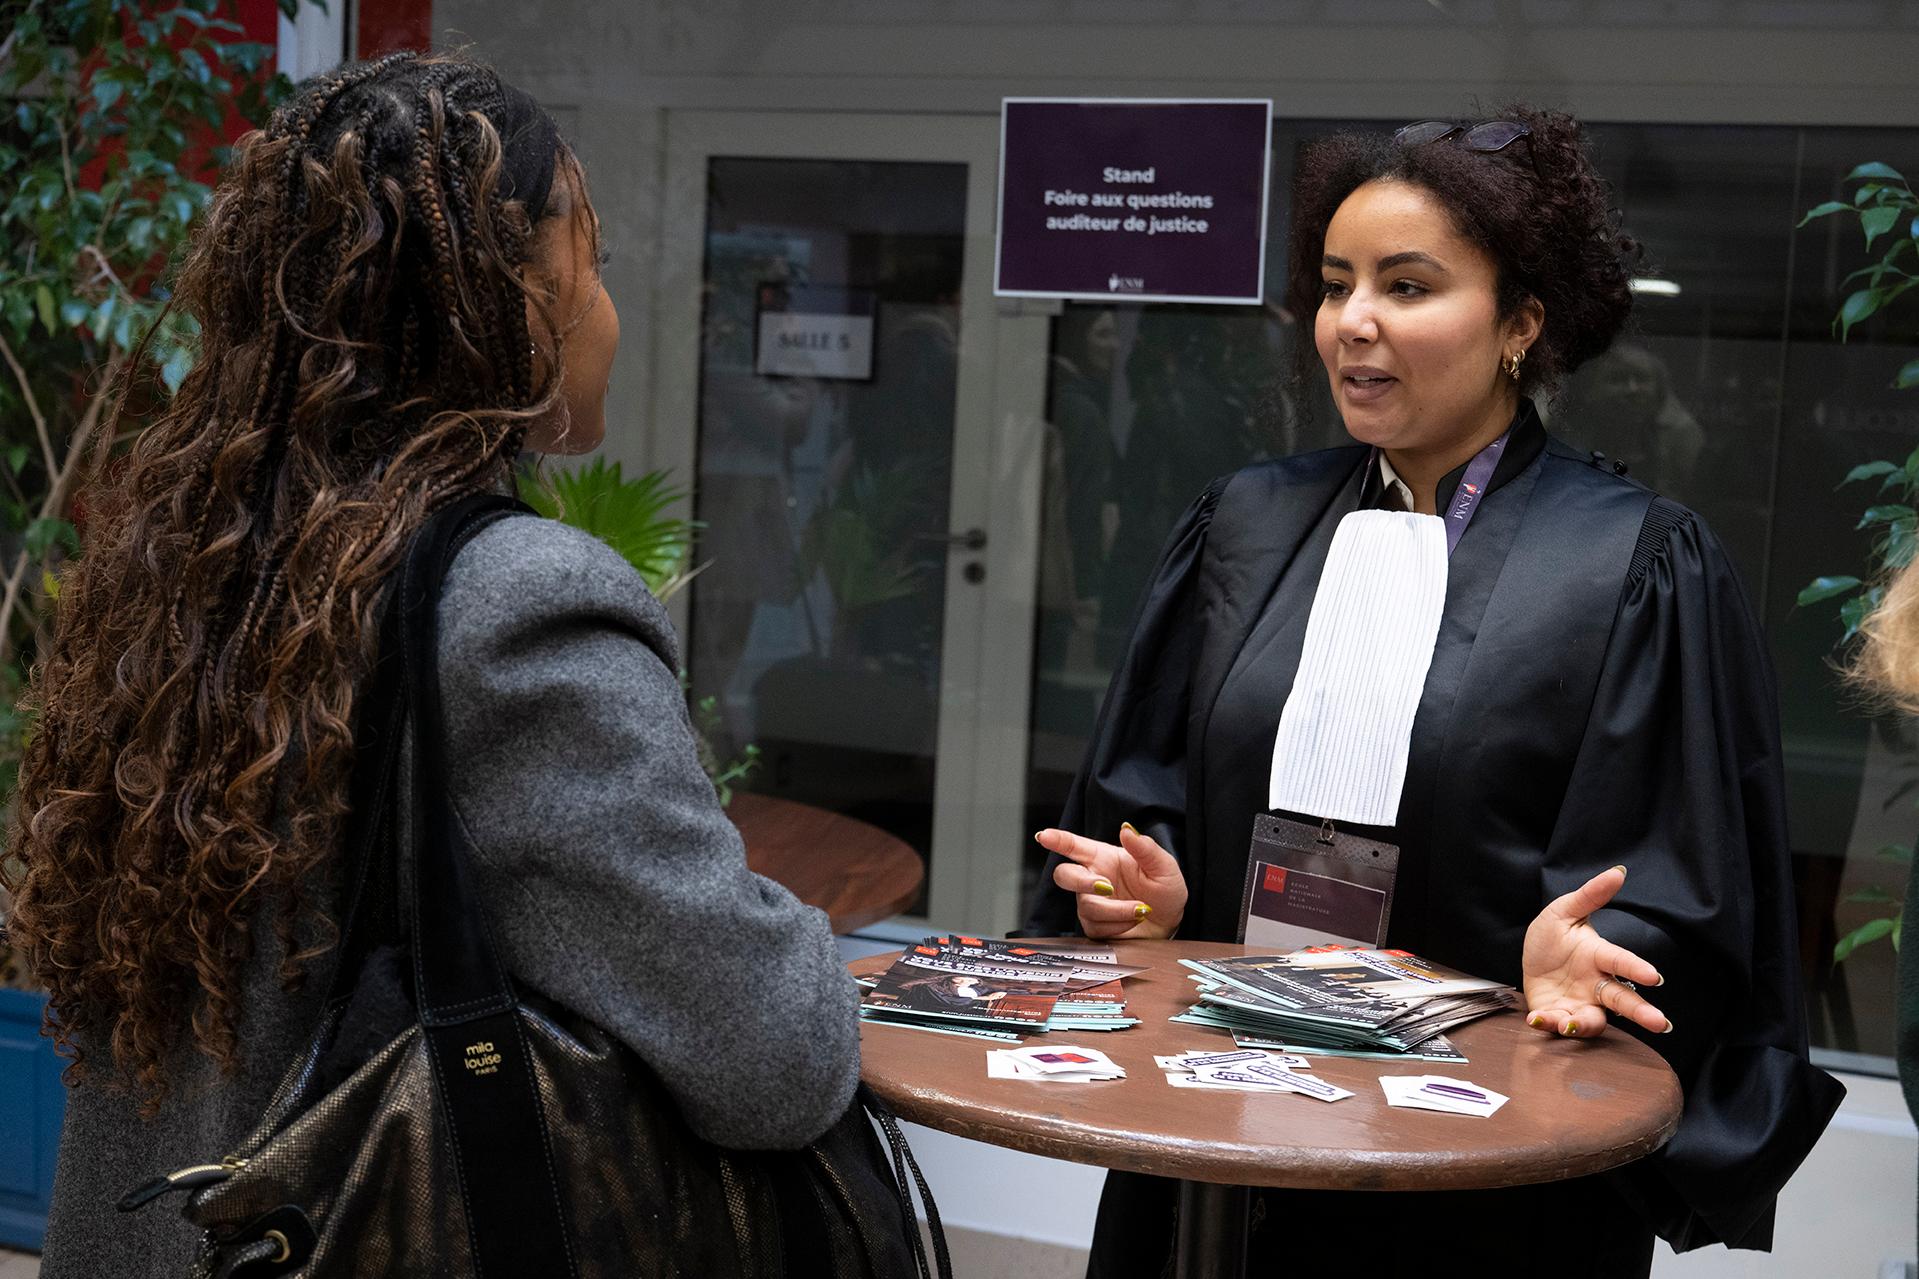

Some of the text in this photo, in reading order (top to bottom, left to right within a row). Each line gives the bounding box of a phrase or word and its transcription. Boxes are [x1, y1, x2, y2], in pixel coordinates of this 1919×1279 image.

[1103, 167, 1155, 184] Stand
[1044, 190, 1214, 210] Foire aux questions
[1046, 214, 1209, 235] auditeur de justice
[1454, 494, 1473, 520] ENM
[466, 1042, 494, 1056] mila
[463, 1053, 502, 1070] louise
